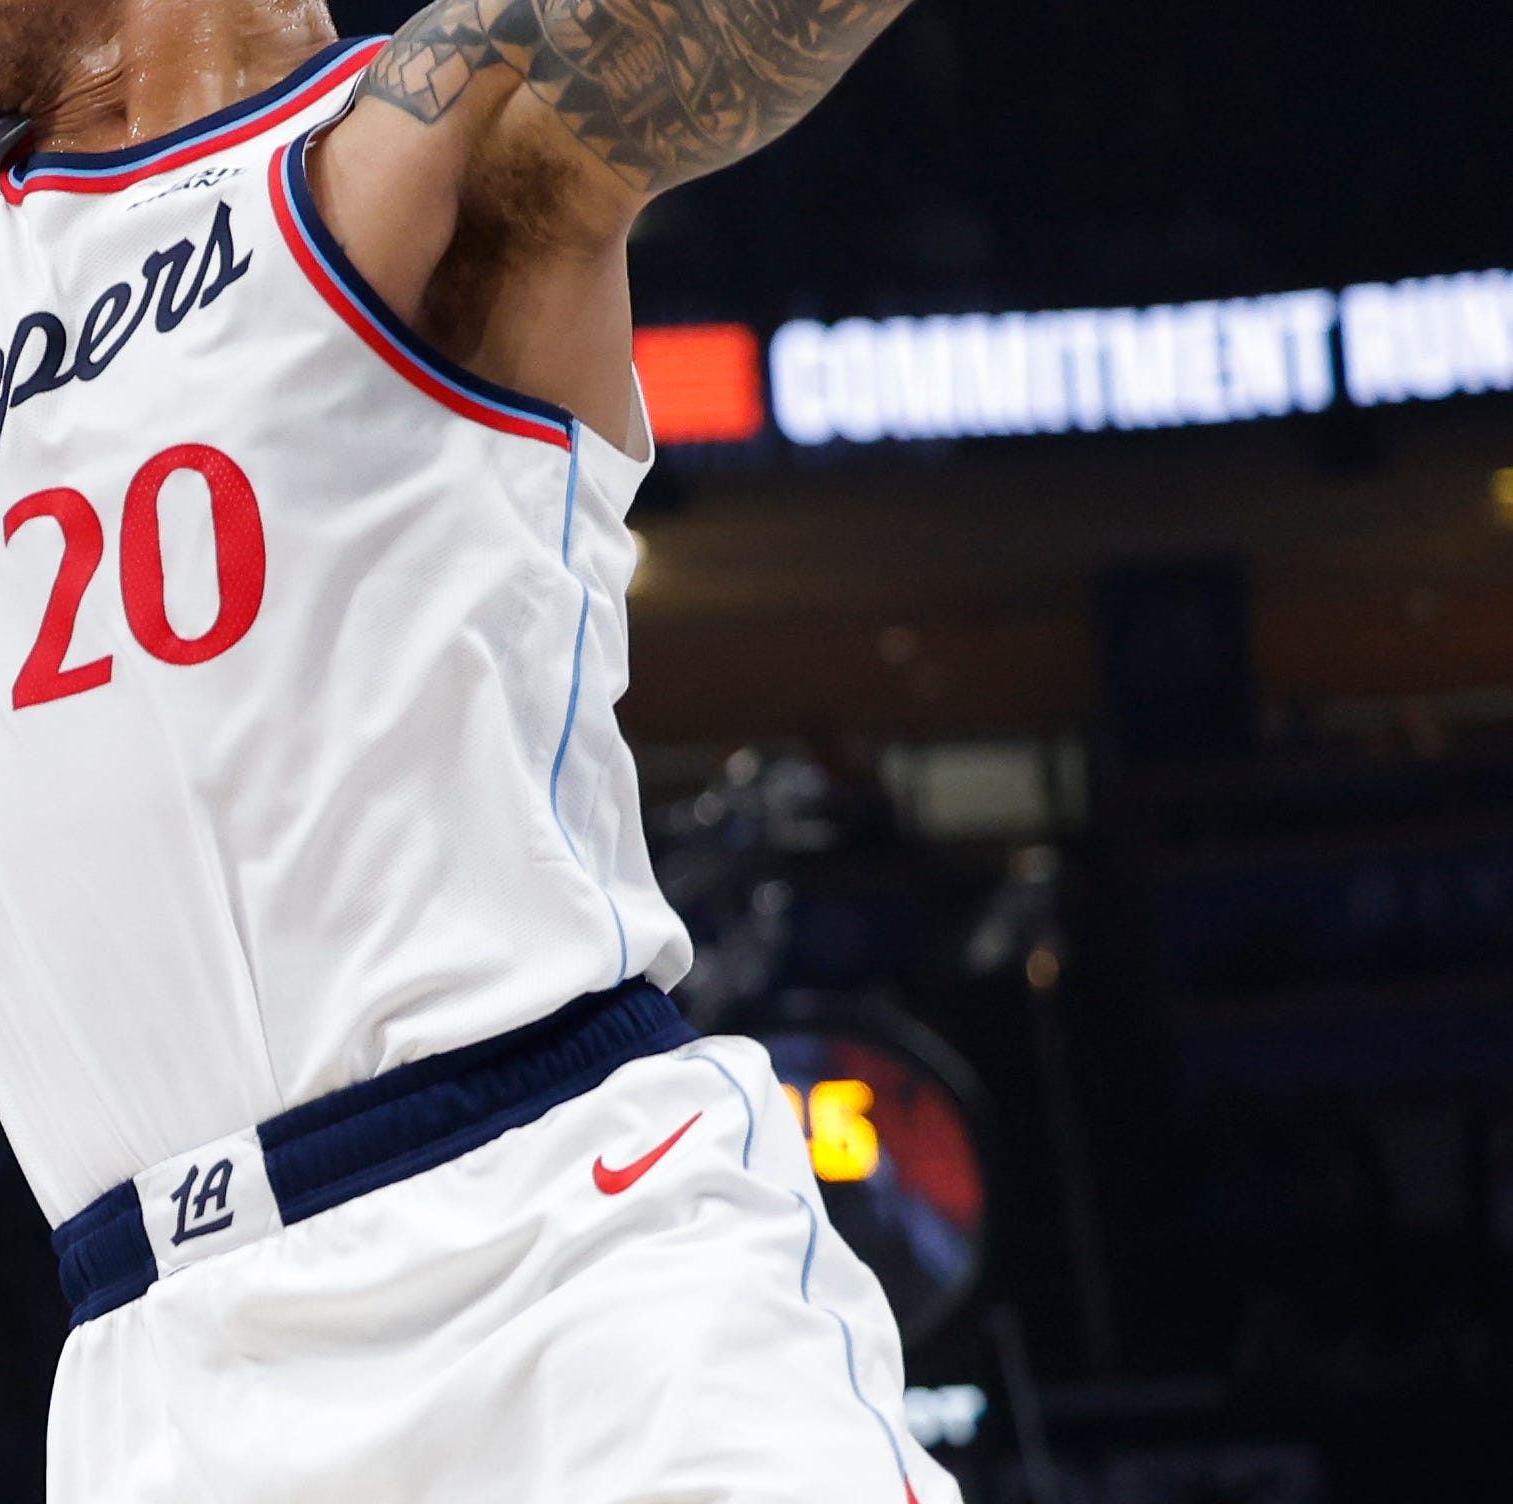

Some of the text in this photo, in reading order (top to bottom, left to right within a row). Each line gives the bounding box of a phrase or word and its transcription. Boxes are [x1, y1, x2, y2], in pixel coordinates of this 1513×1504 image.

[773, 288, 1335, 445] COMMITMENT
[3, 443, 266, 711] 20
[171, 1157, 234, 1246] LA
